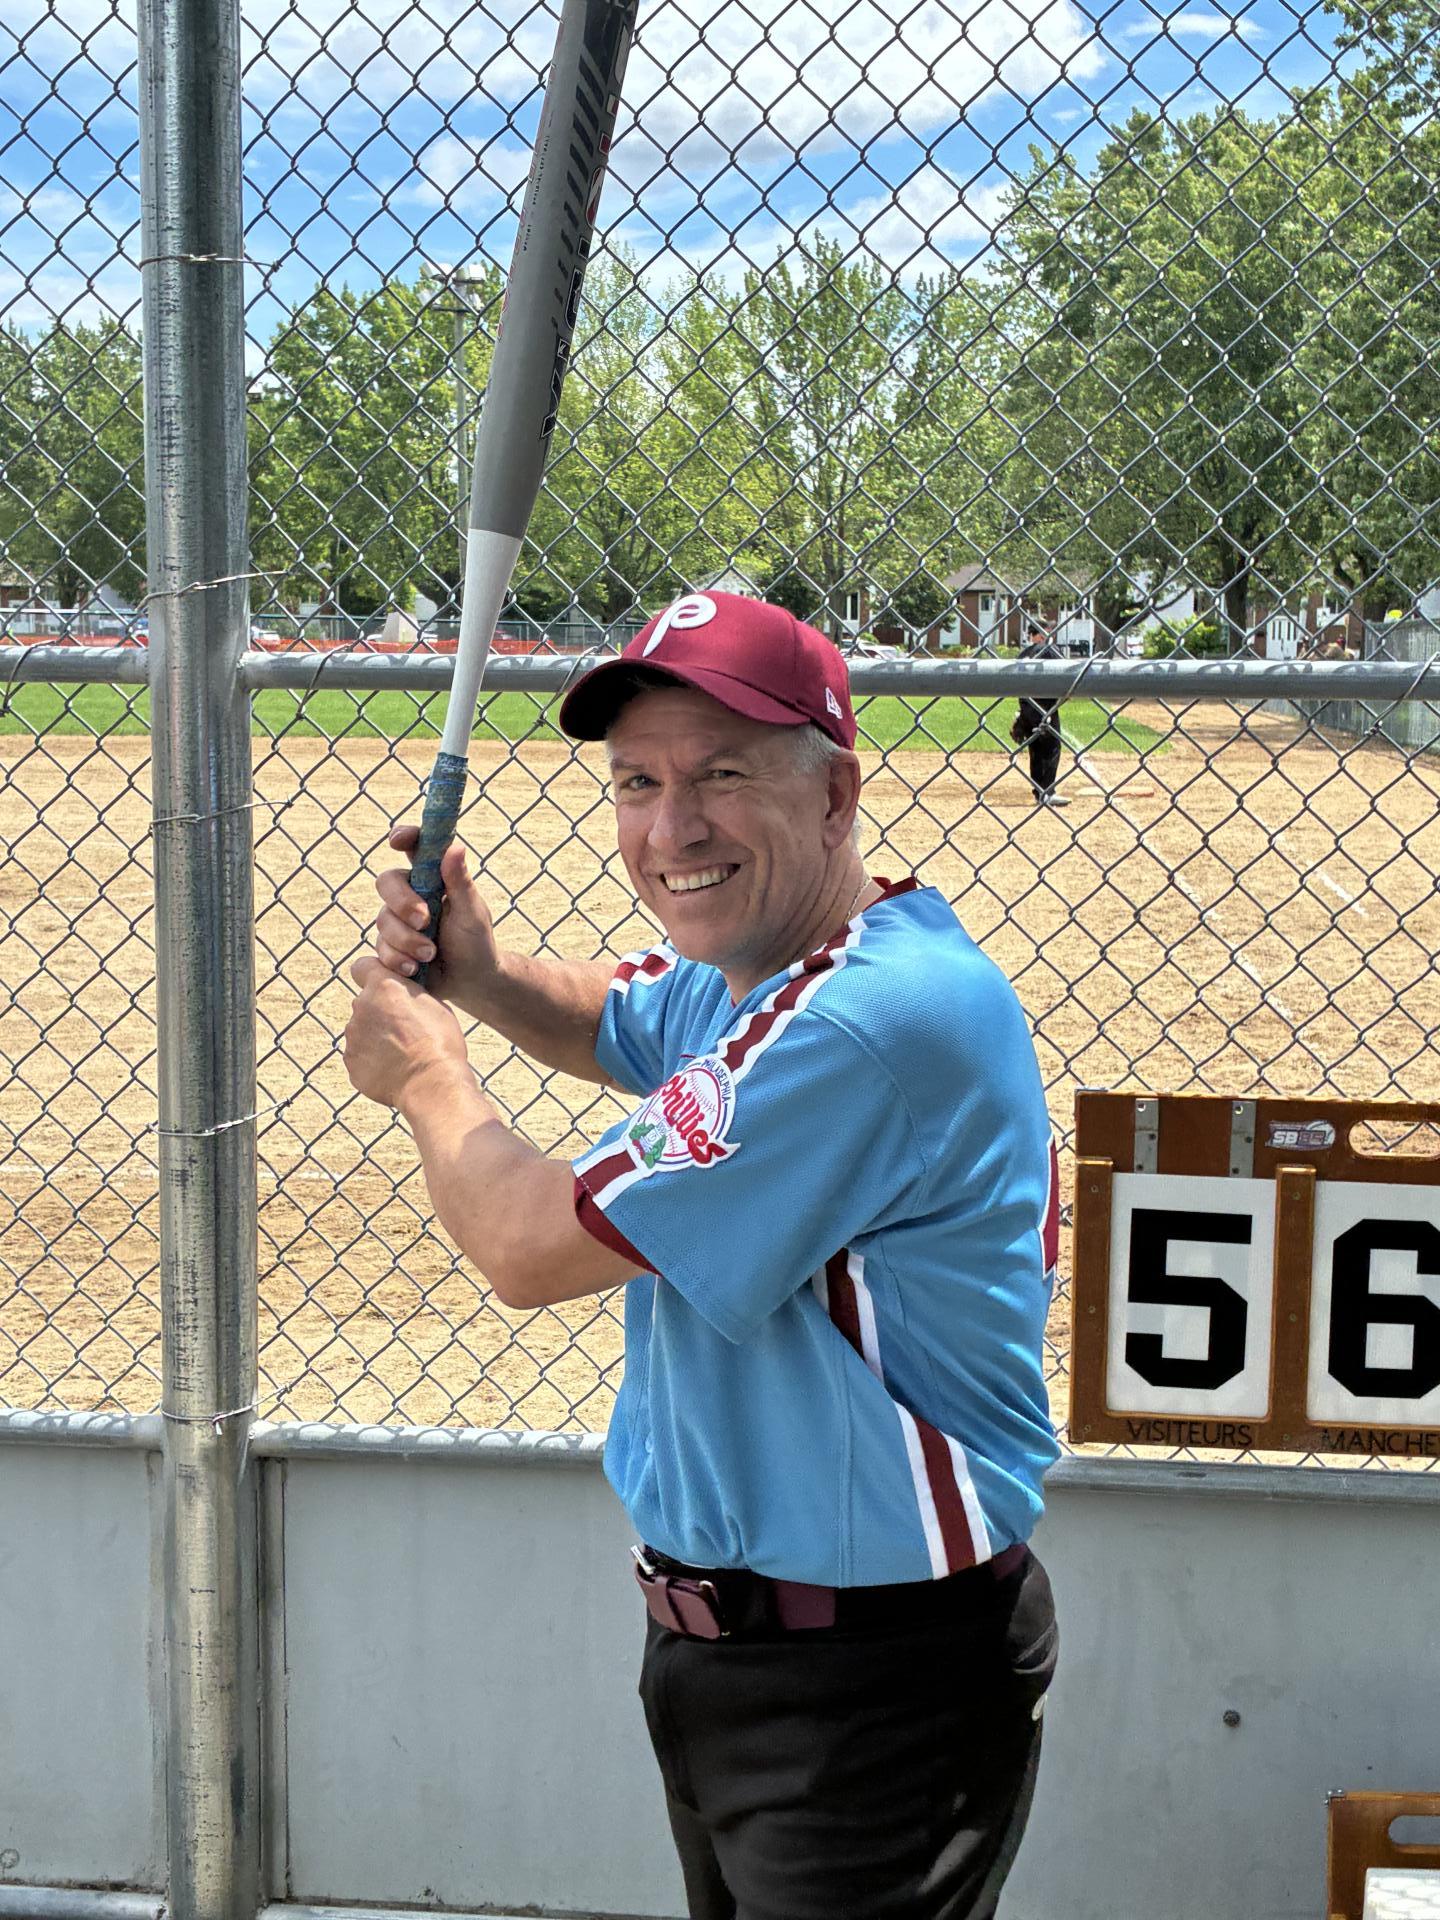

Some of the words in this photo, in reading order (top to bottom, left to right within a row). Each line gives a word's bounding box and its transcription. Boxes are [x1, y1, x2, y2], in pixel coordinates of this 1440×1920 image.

[642, 593, 718, 658] P
[660, 1075, 728, 1165] Phillies
[1125, 1208, 1253, 1391] 5
[1327, 1218, 1440, 1400] 6
[1126, 1419, 1253, 1447] VISITEURS
[1321, 1428, 1439, 1456] MANCHE
